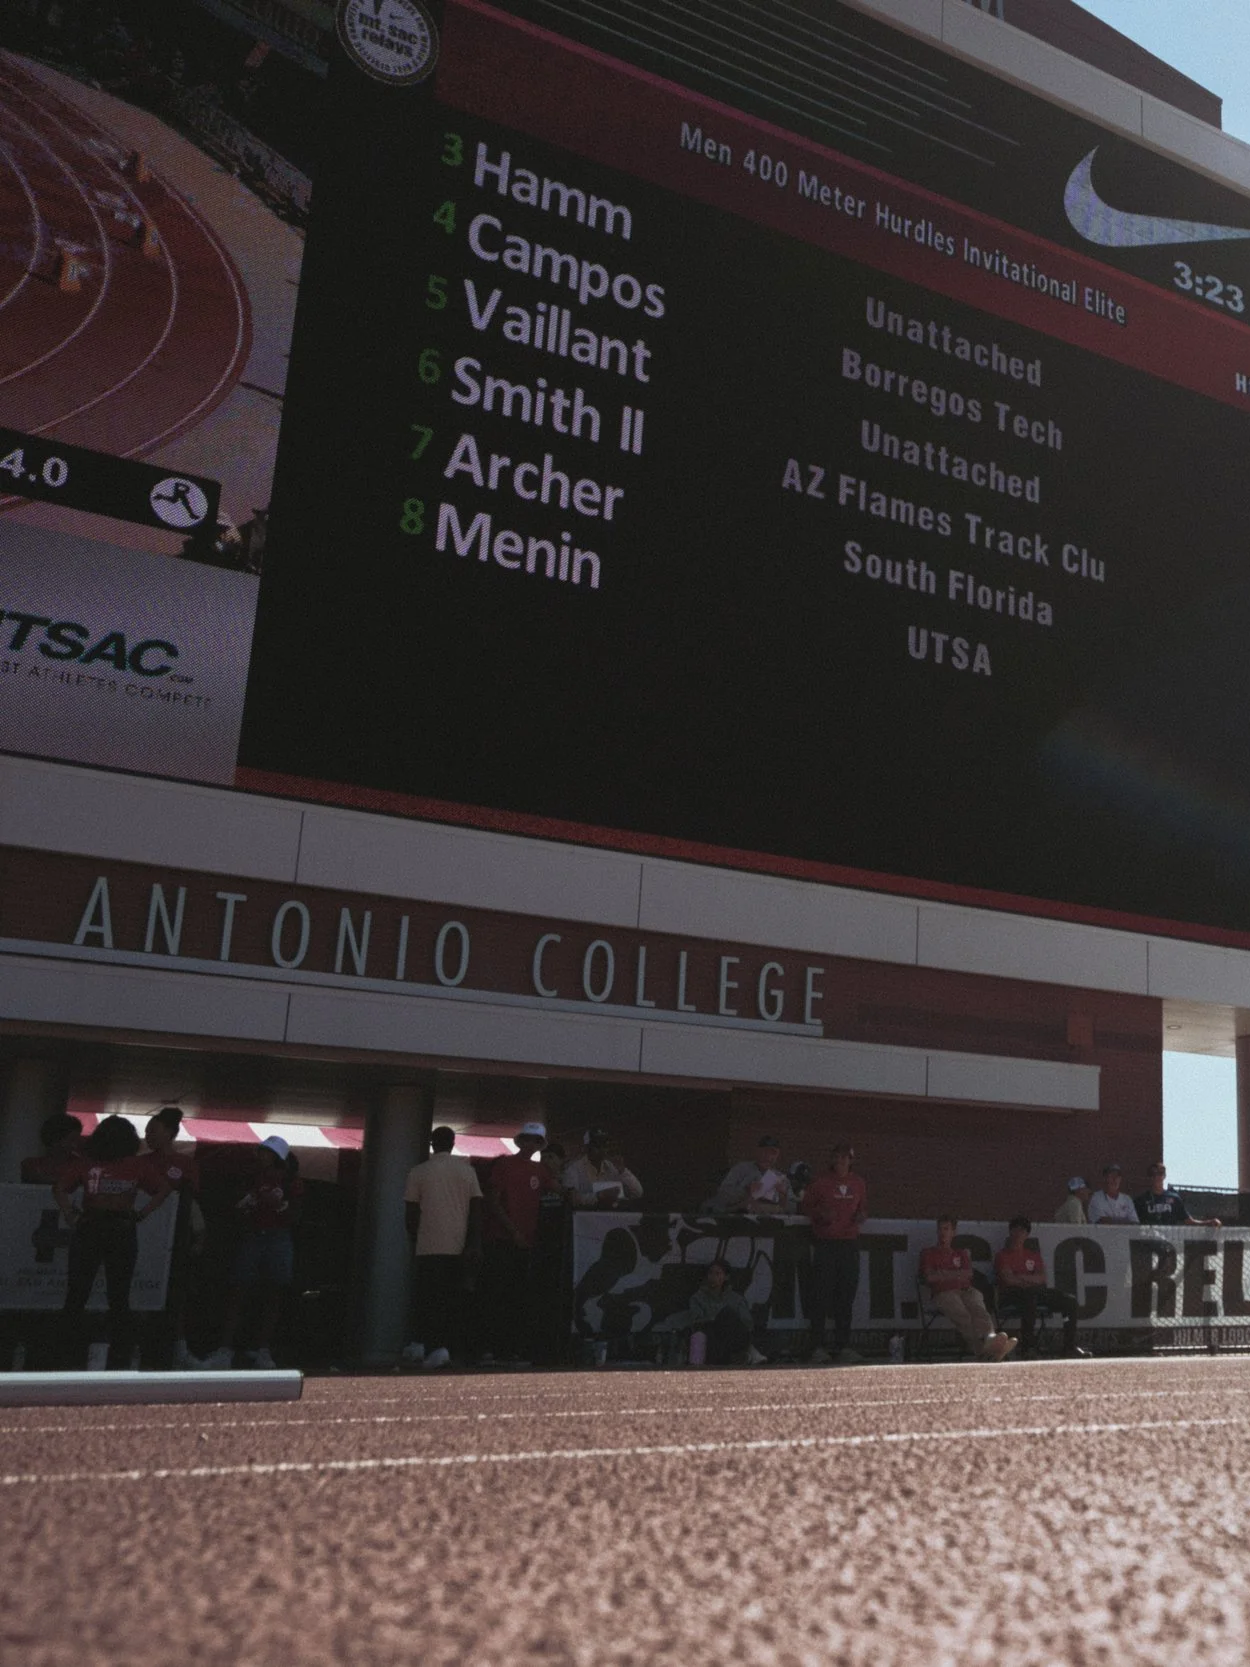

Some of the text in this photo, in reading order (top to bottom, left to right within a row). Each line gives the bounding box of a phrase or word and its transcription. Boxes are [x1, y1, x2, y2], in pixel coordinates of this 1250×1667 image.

[441, 133, 632, 240] 3 Hamm
[680, 121, 1126, 325] Men 400 Meter Hurdles Invitational Elite
[433, 200, 666, 319] 4 Campos
[1174, 261, 1245, 313] 3:23
[426, 275, 653, 383] 5 Vaillant
[866, 297, 1042, 387] Unattached
[418, 349, 441, 385] 6
[451, 356, 601, 442] Smith
[842, 348, 1063, 451] Borregos Tech
[411, 424, 625, 521] 7 Archer
[861, 420, 1040, 504] Unattached
[399, 497, 601, 589] 8 Menin
[782, 458, 1105, 583] AZ Flames Track Clu
[844, 540, 1053, 626] South Florida
[0, 610, 178, 677] TSAC
[28, 665, 117, 692] ATHLETES
[907, 625, 992, 676] UTSA
[74, 876, 826, 1027] ANTONIO COLLEGE
[1147, 1202, 1172, 1213] USA
